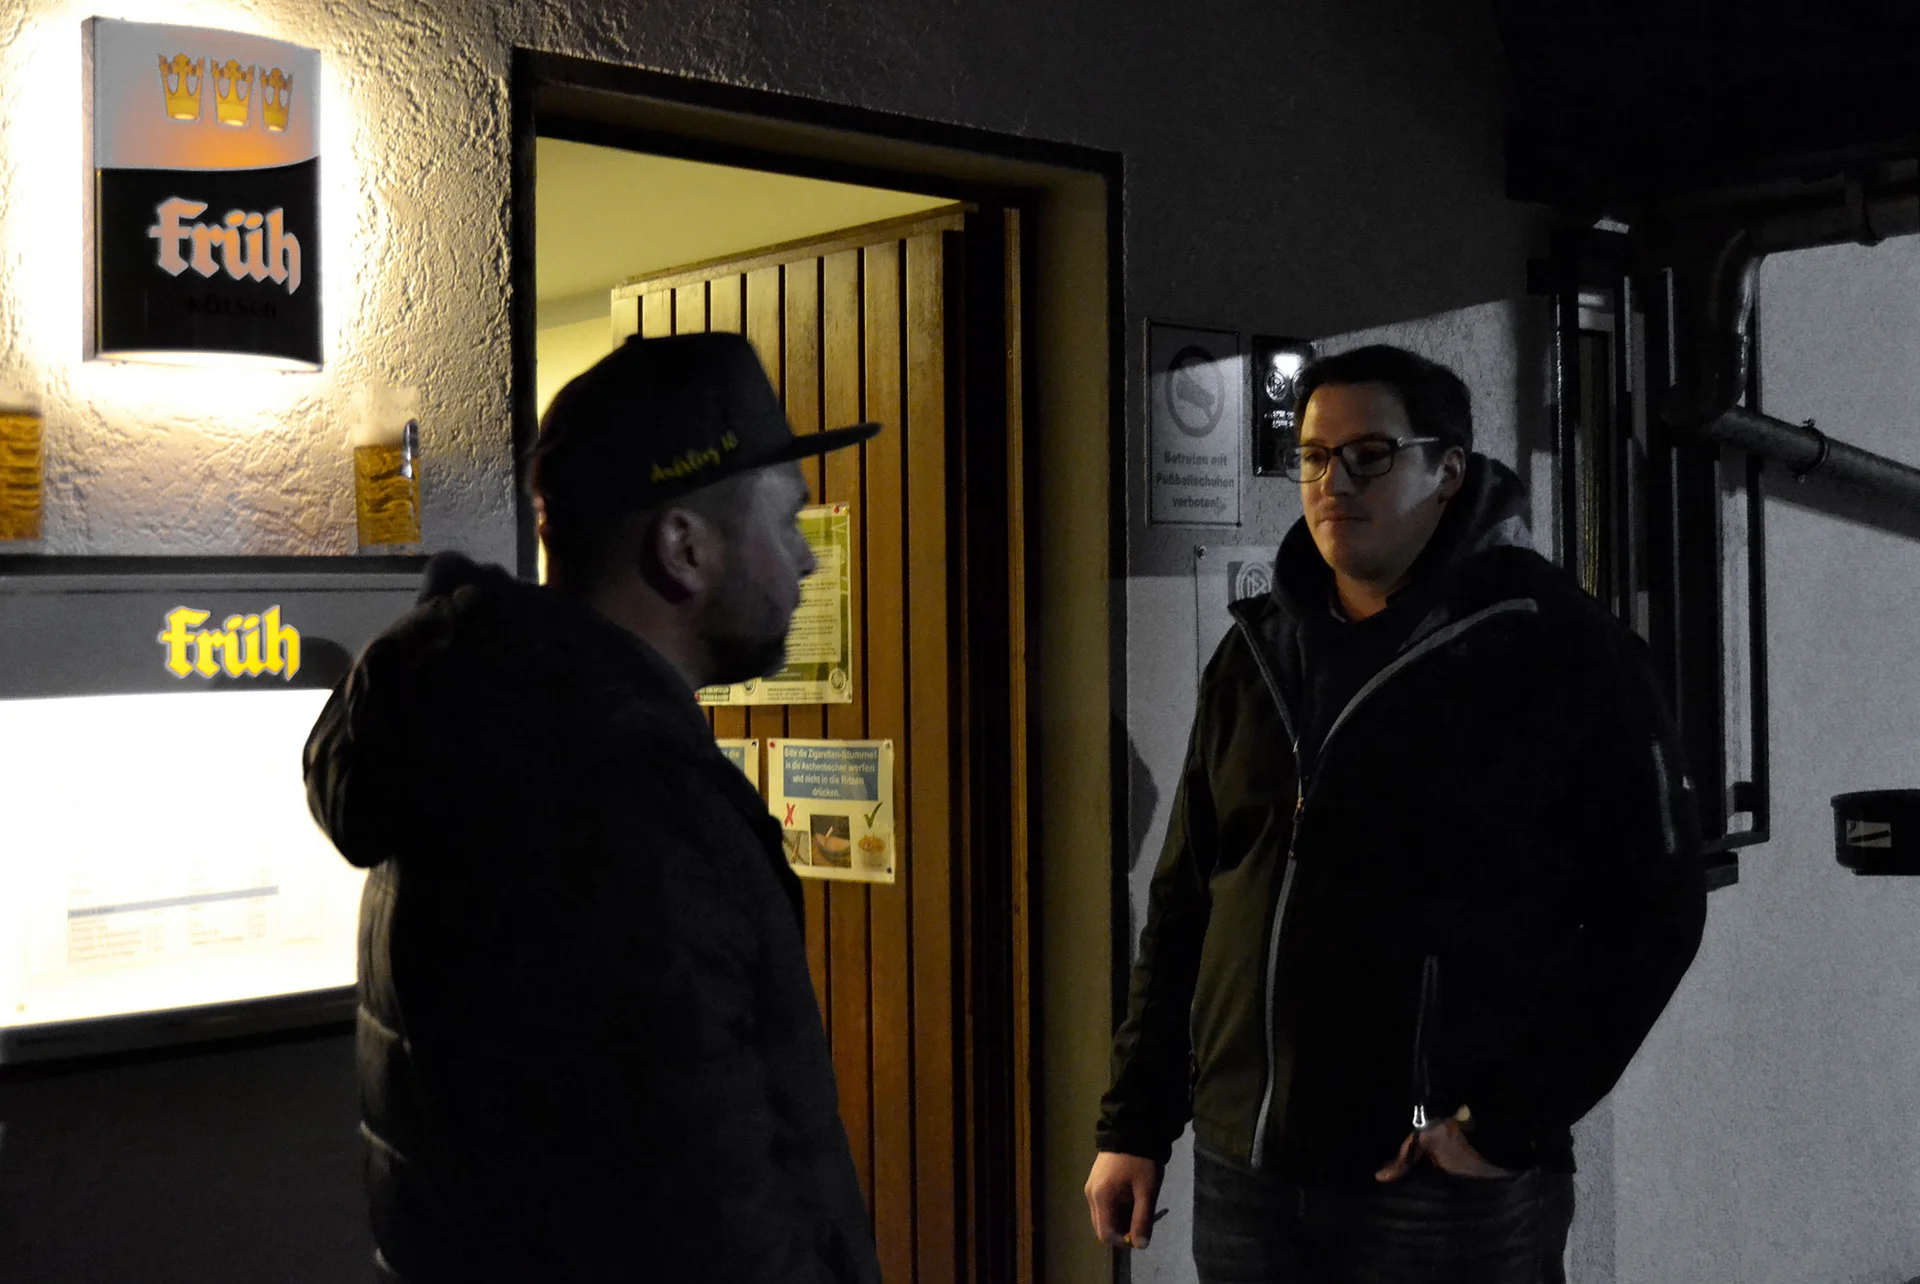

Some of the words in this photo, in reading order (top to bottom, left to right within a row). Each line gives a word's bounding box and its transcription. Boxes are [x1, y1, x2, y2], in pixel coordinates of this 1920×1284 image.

[148, 196, 302, 296] Früh
[1164, 451, 1208, 465] Betreten
[1210, 454, 1228, 467] mit
[1156, 472, 1235, 488] Fußballschuhen
[158, 604, 302, 681] Früh
[848, 763, 875, 772] werfen
[792, 773, 804, 783] und
[805, 773, 820, 784] nicht
[829, 774, 840, 784] die
